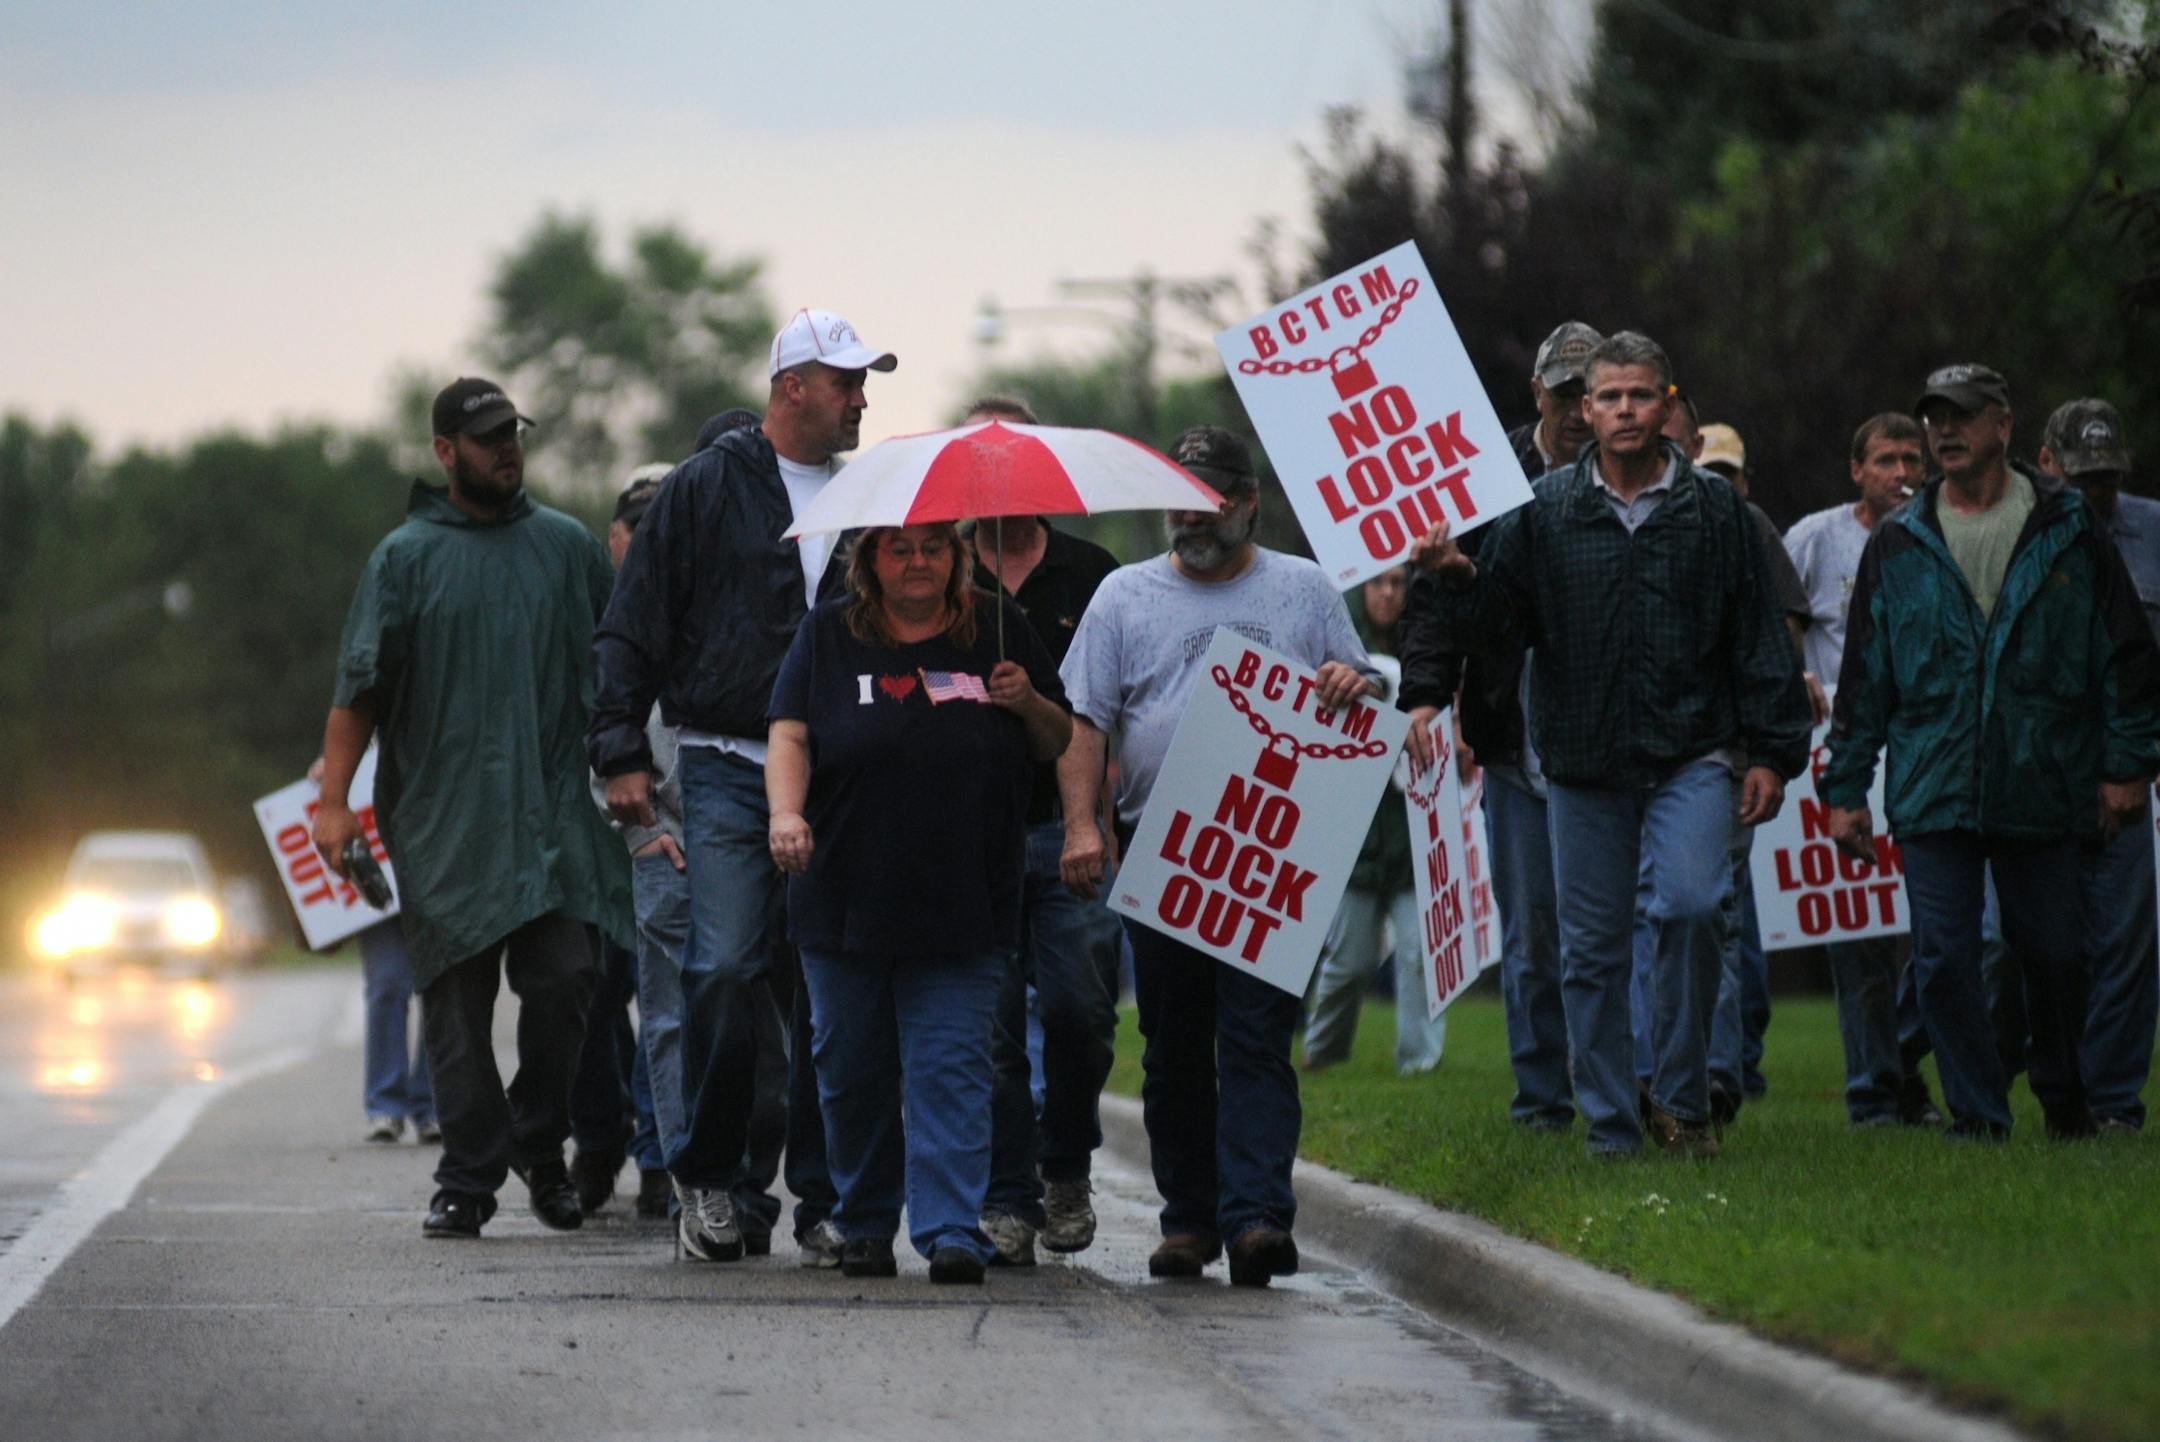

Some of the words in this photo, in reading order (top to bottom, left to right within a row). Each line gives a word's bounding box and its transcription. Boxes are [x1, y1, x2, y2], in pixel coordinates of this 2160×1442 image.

[1248, 265, 1397, 360] BCTGM
[1327, 384, 1418, 459] NO
[1316, 410, 1480, 524] LOCK
[1358, 467, 1478, 561] OUT
[857, 673, 874, 704] I
[1213, 773, 1301, 850] NO
[1799, 797, 1832, 841] N
[276, 821, 337, 908] OUT
[1158, 809, 1318, 923] LOCK
[1428, 838, 1449, 897] NO
[1157, 873, 1282, 964] OUT
[1425, 878, 1465, 956] LOCK
[1797, 881, 1899, 936] OUT
[1435, 934, 1465, 1002] OUT
